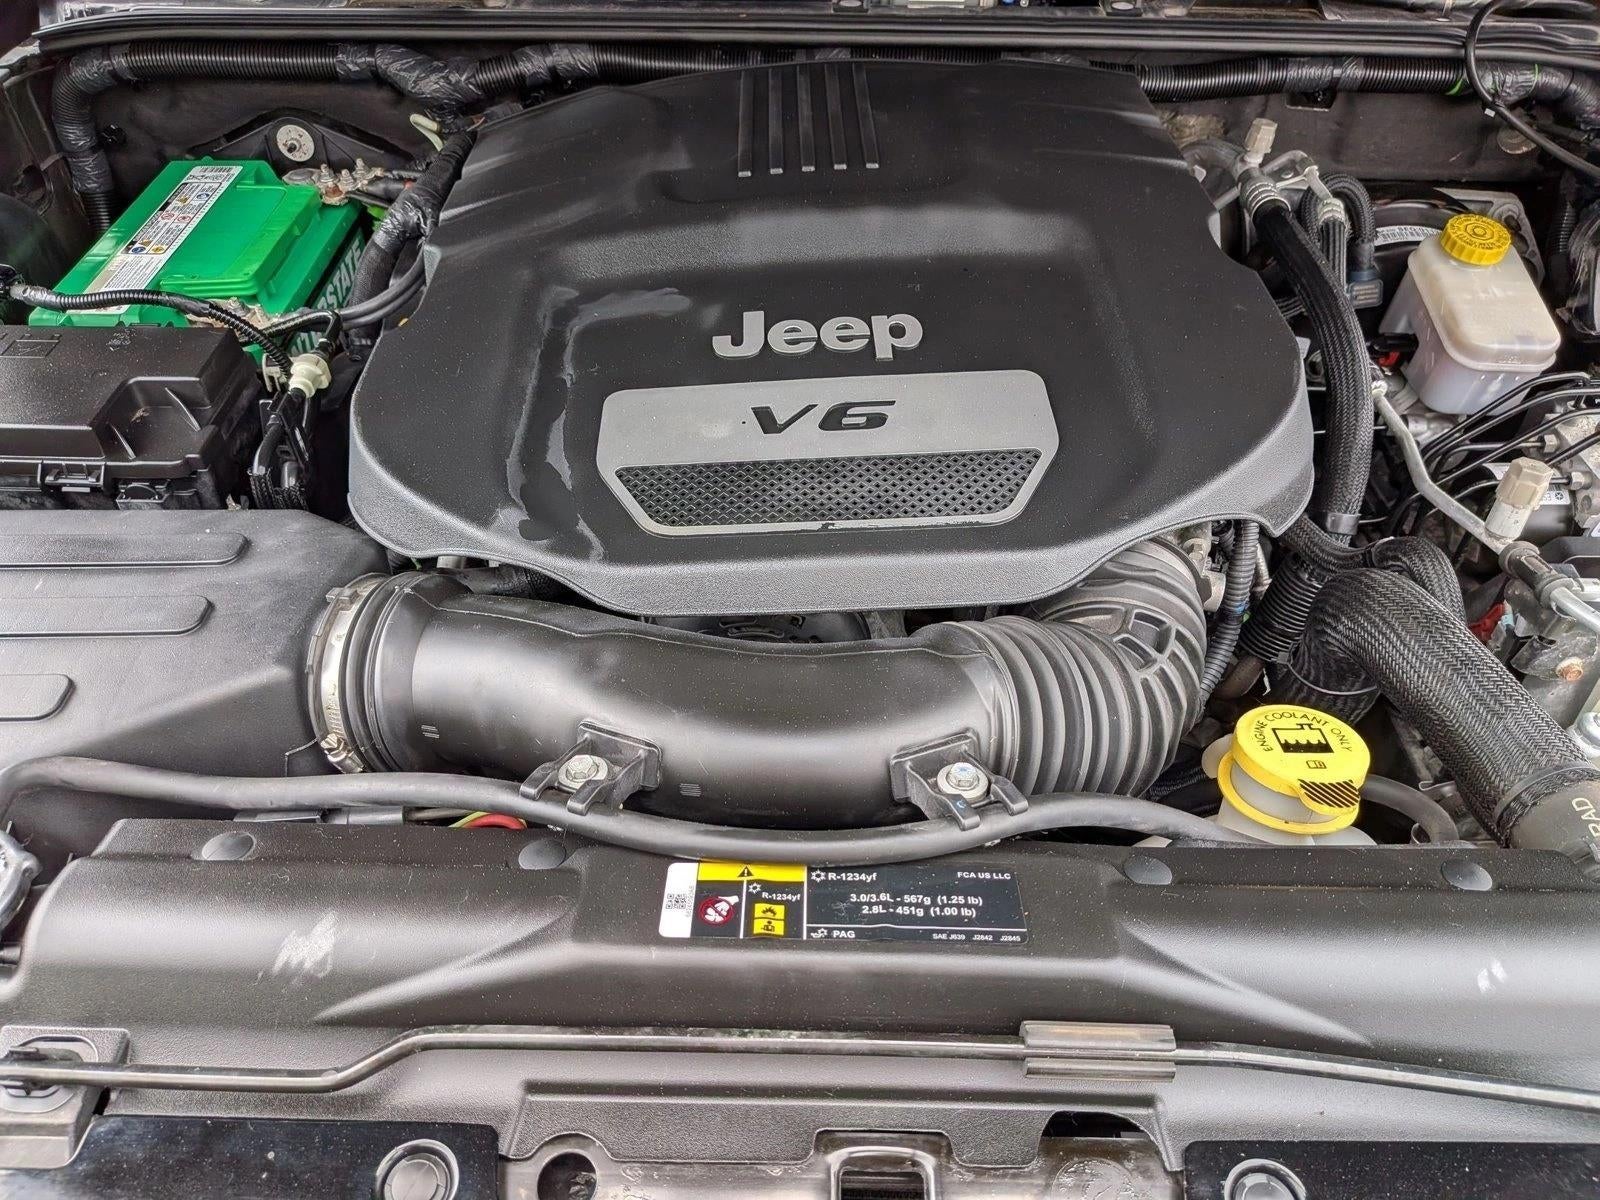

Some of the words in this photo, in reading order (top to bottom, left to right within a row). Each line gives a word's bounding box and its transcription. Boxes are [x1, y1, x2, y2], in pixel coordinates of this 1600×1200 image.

[712, 310, 923, 361] Jeep
[751, 400, 896, 435] V6
[1254, 720, 1273, 752] ENGINE
[1265, 711, 1329, 727] COOLANT
[1330, 727, 1352, 752] ONLY
[828, 872, 877, 882] R-1234yf
[978, 871, 991, 879] US
[993, 872, 1011, 880] LLC
[761, 891, 801, 902] R-1234yf
[850, 892, 894, 903] 3.0/3.6L
[903, 894, 931, 905] 567g
[937, 895, 965, 905] (1.25
[968, 896, 983, 906] lb)
[861, 905, 886, 914] 2.8L
[895, 906, 924, 917] 451g
[930, 906, 958, 917] (1.00
[961, 907, 976, 918] lb)
[832, 930, 855, 938] PAG
